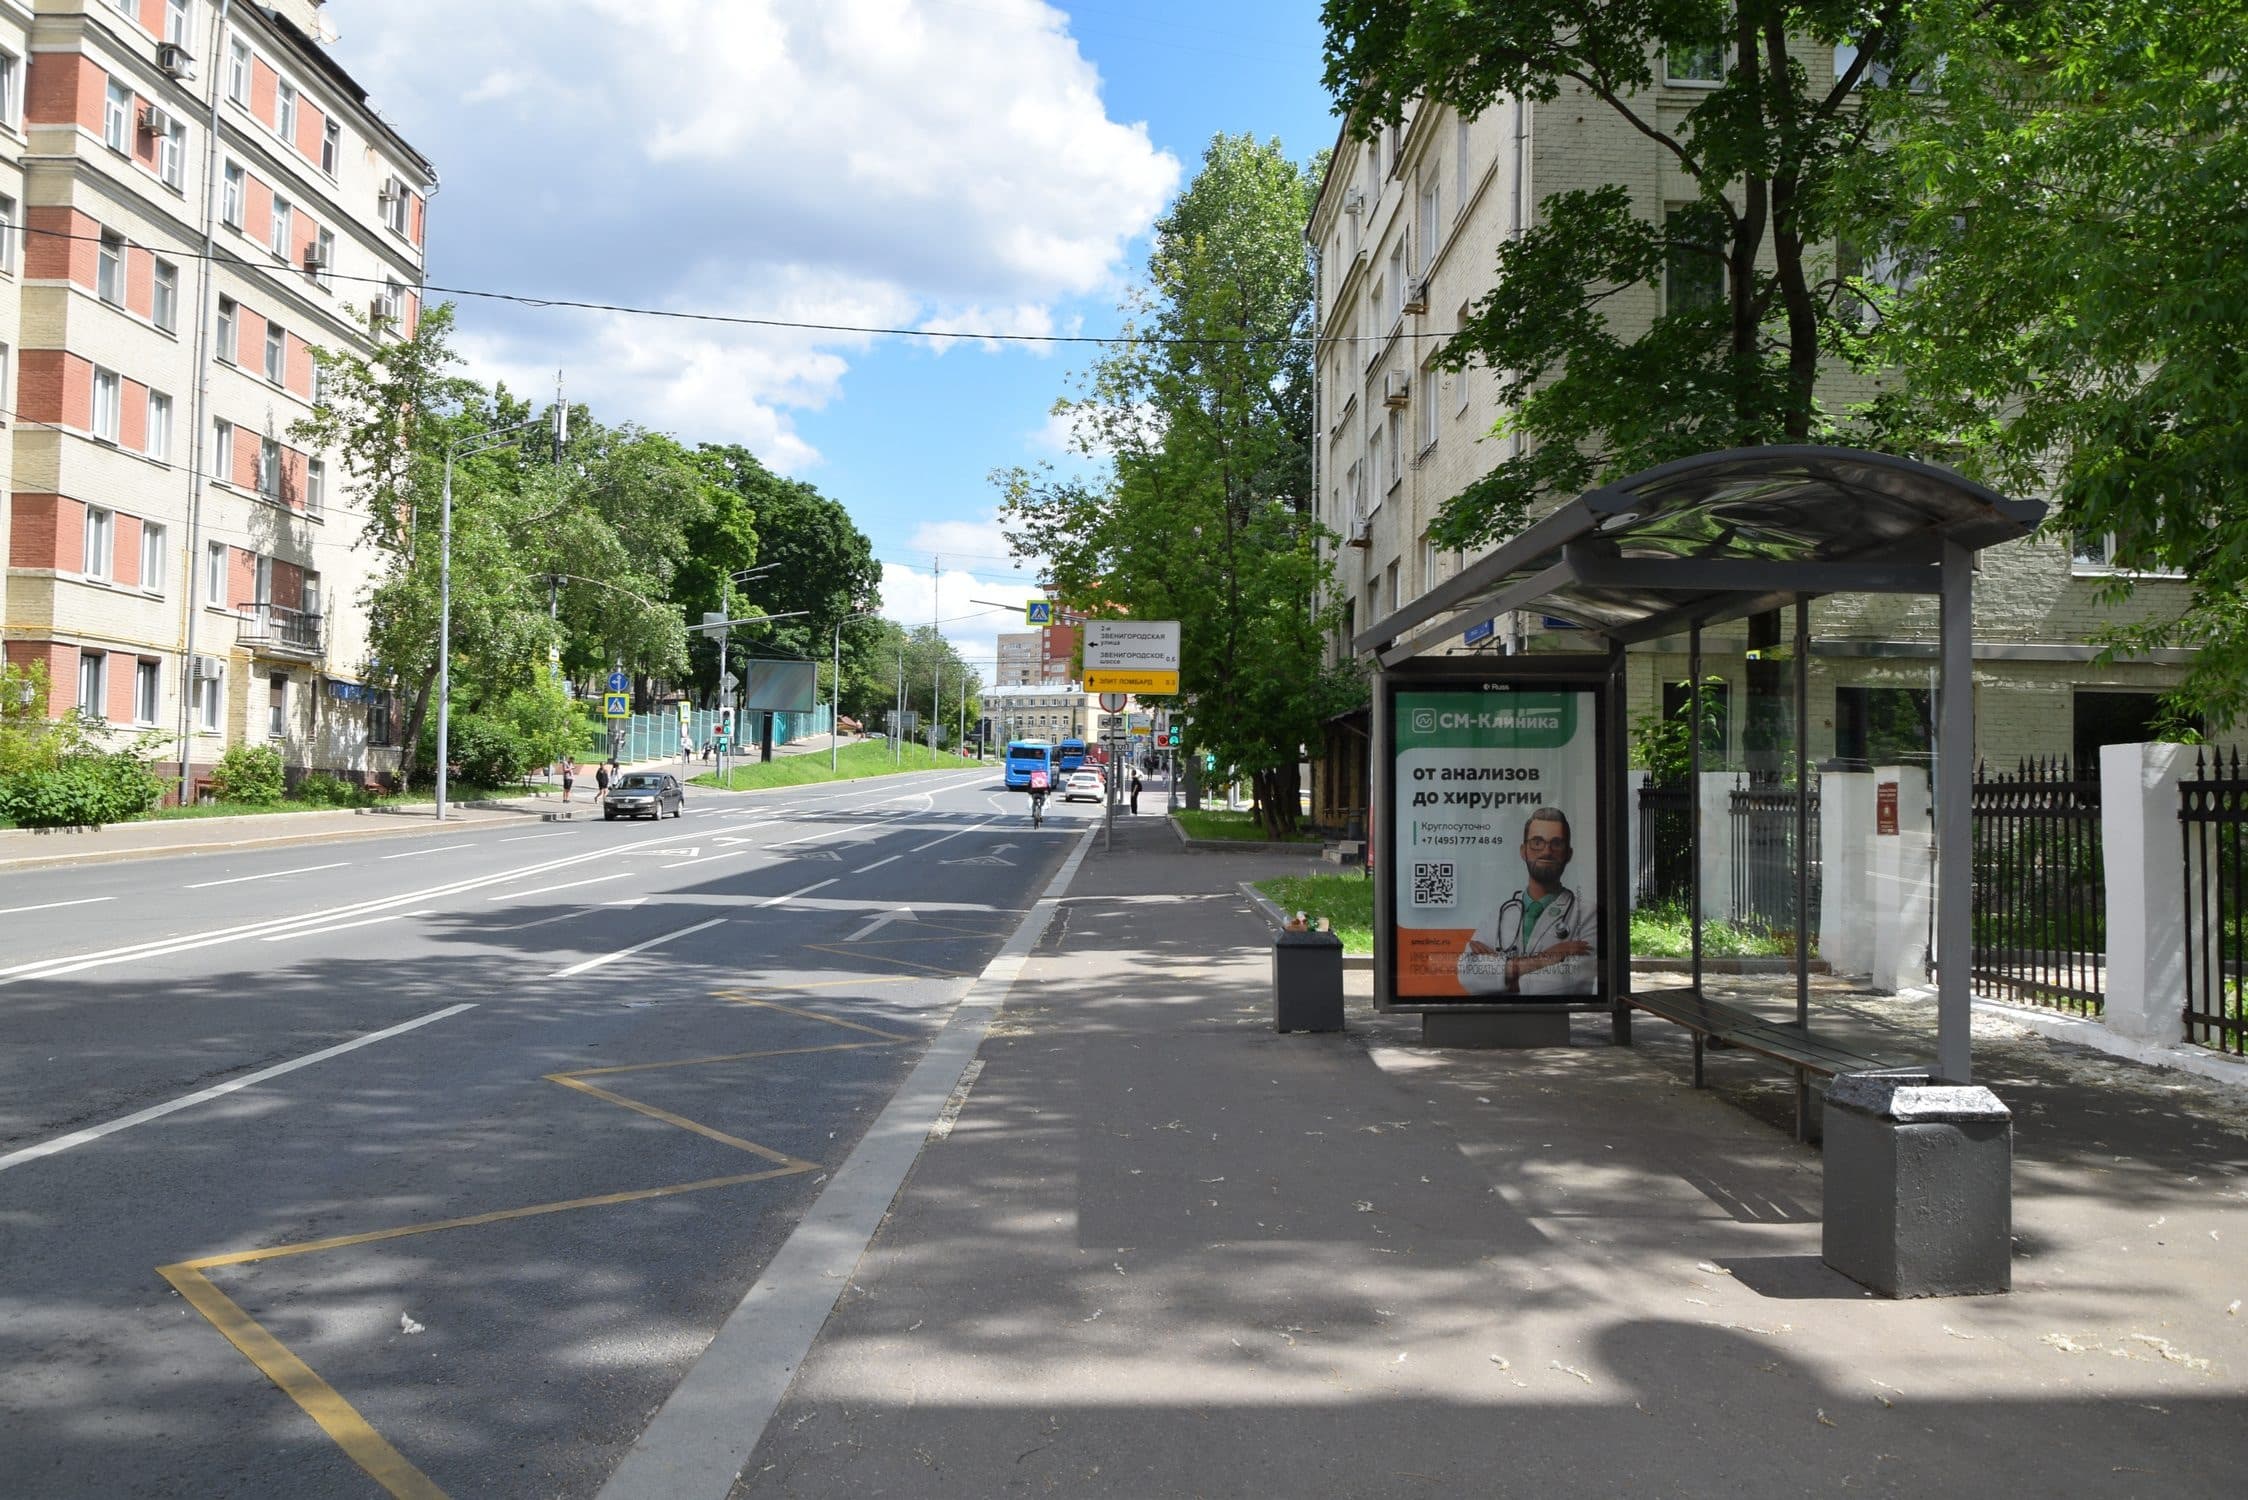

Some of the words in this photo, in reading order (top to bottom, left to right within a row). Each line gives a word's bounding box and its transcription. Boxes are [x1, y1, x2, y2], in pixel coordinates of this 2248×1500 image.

[1491, 683, 1510, 691] Russ
[1439, 712, 1559, 729] СМ-Клиника
[1413, 767, 1436, 780] от
[1441, 767, 1540, 781] анализов
[1412, 791, 1439, 807] до
[1443, 791, 1542, 809] хирургии
[1421, 822, 1491, 832] Круглосуточно
[1421, 836, 1433, 845] +7
[1434, 836, 1458, 846] (495)
[1460, 836, 1476, 845] 777
